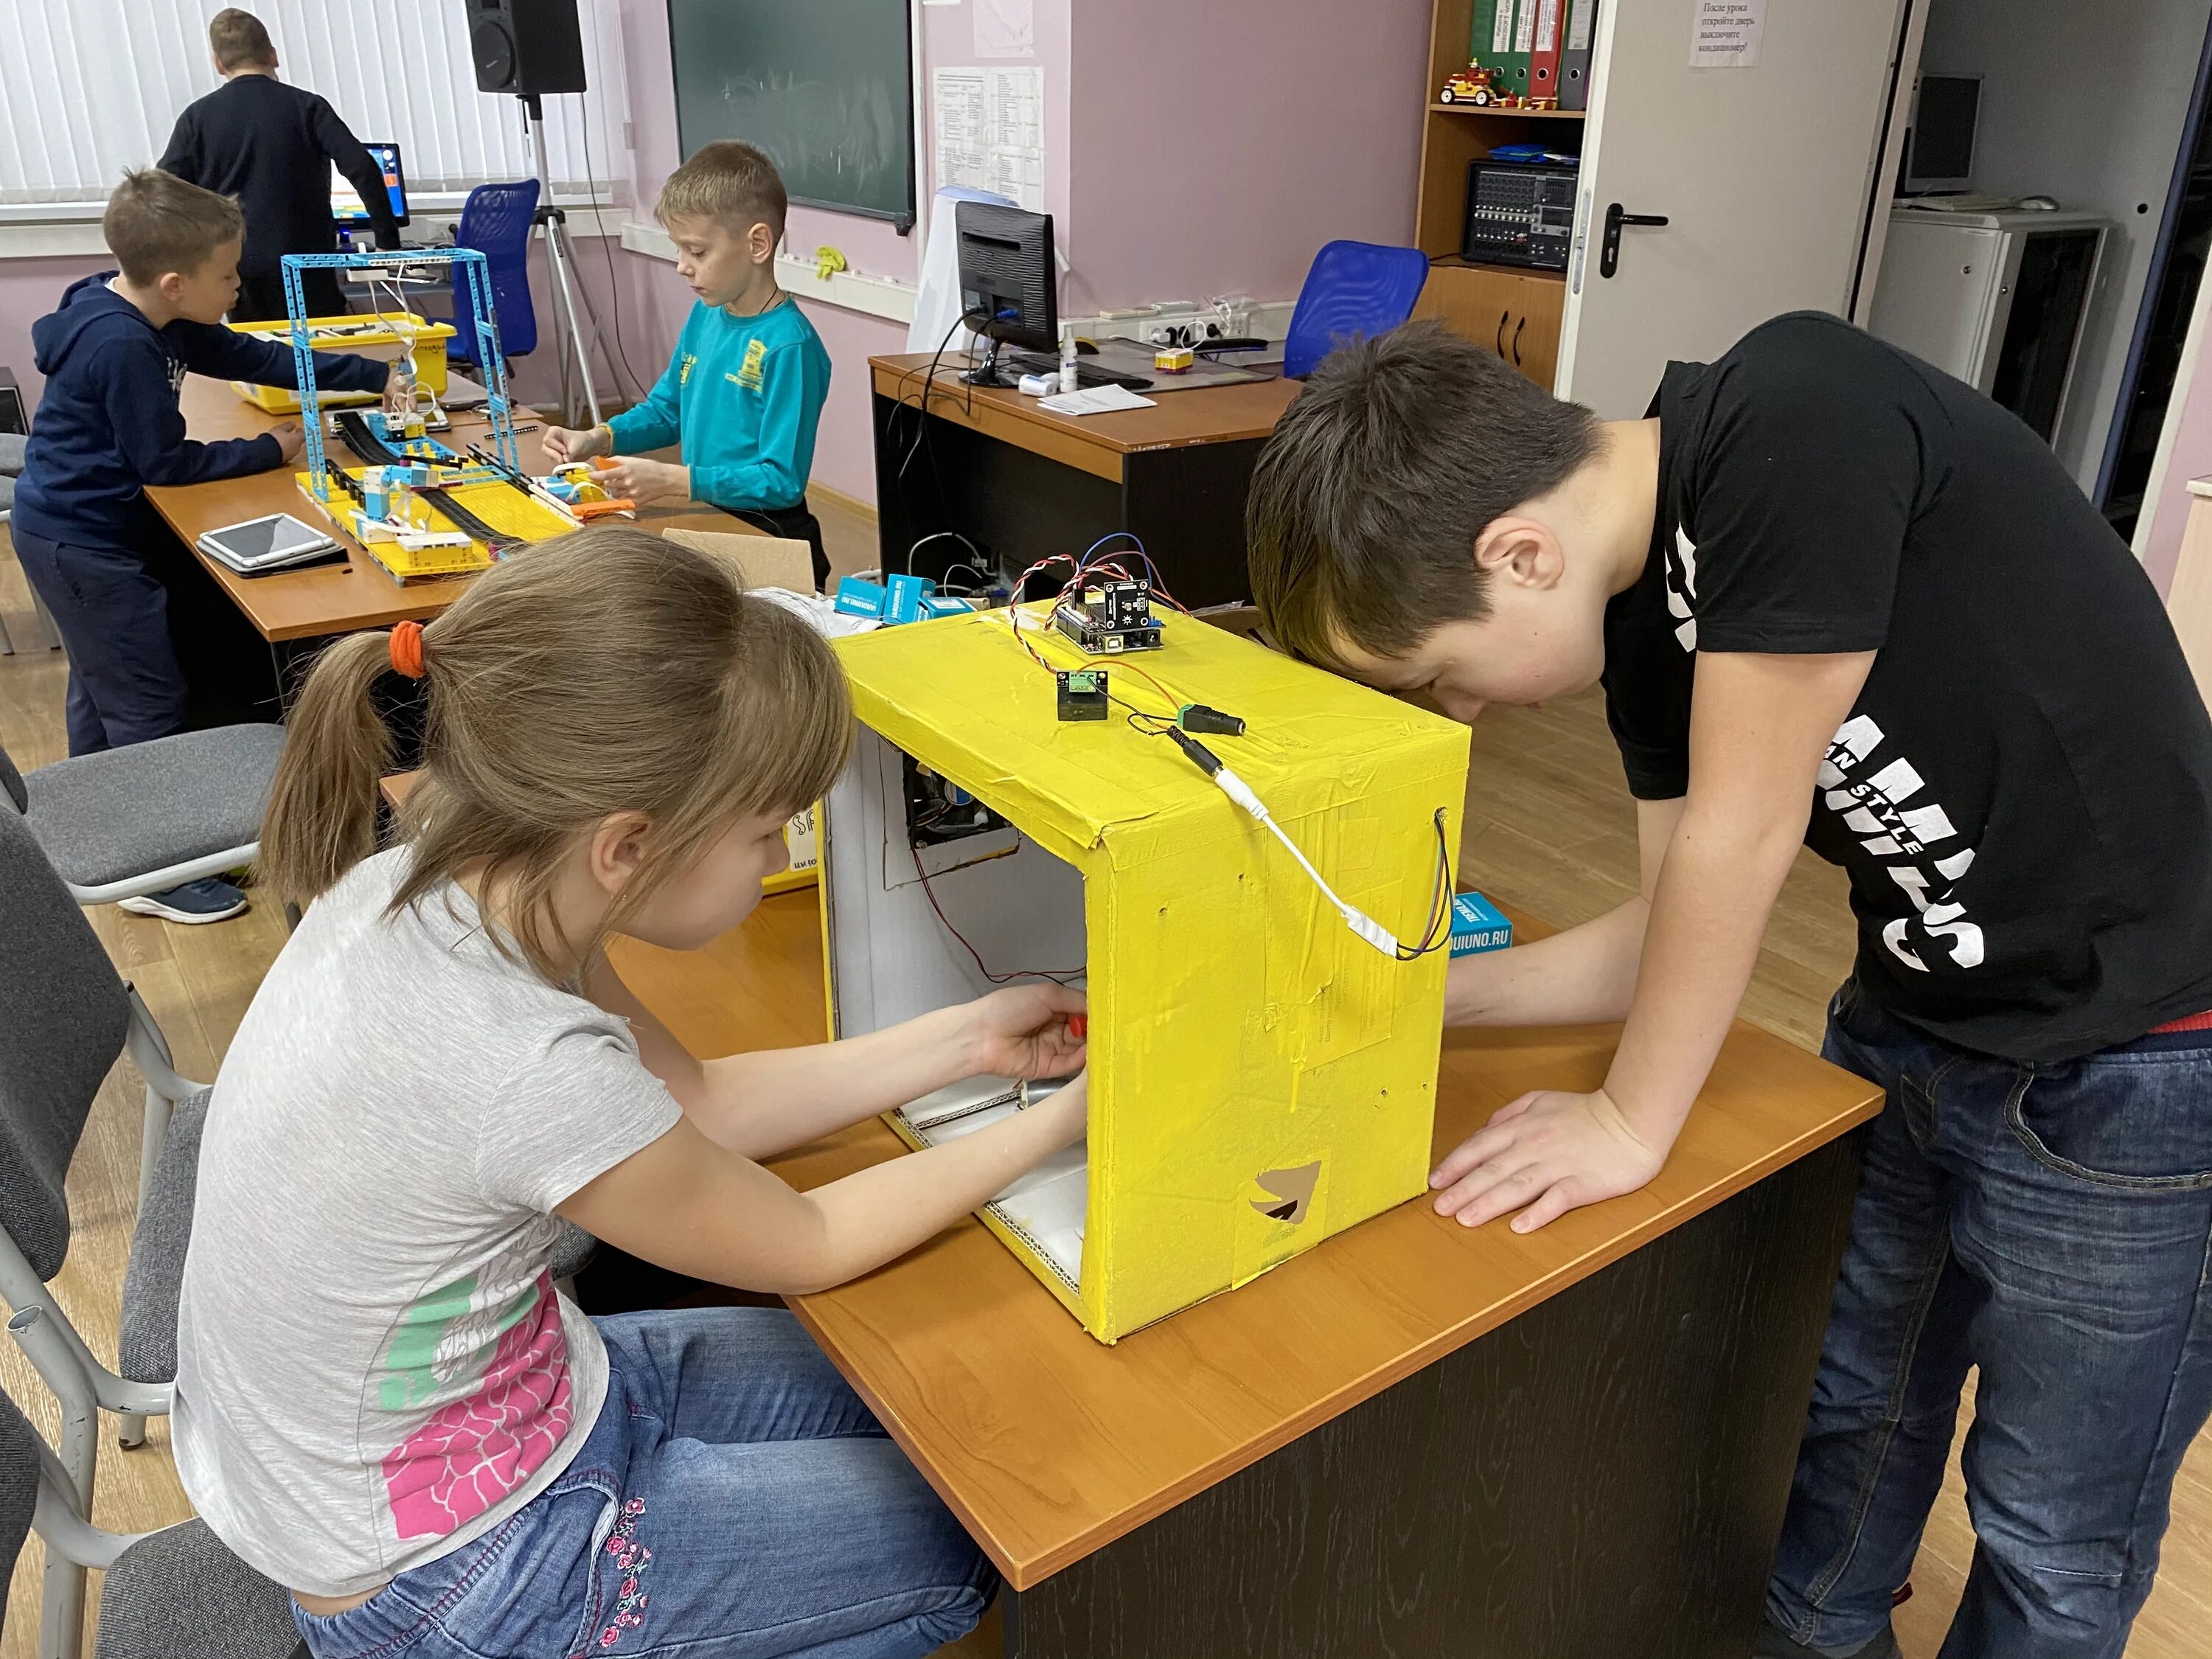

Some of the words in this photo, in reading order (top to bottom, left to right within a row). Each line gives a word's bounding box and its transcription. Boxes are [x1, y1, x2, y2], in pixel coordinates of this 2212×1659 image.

[1703, 3, 1726, 12] После
[1727, 4, 1747, 13] урока
[1702, 17, 1733, 27] откройте
[1735, 18, 1755, 27] дверь
[1698, 43, 1747, 53] кондиционер!
[1850, 784, 1924, 855] STYLE
